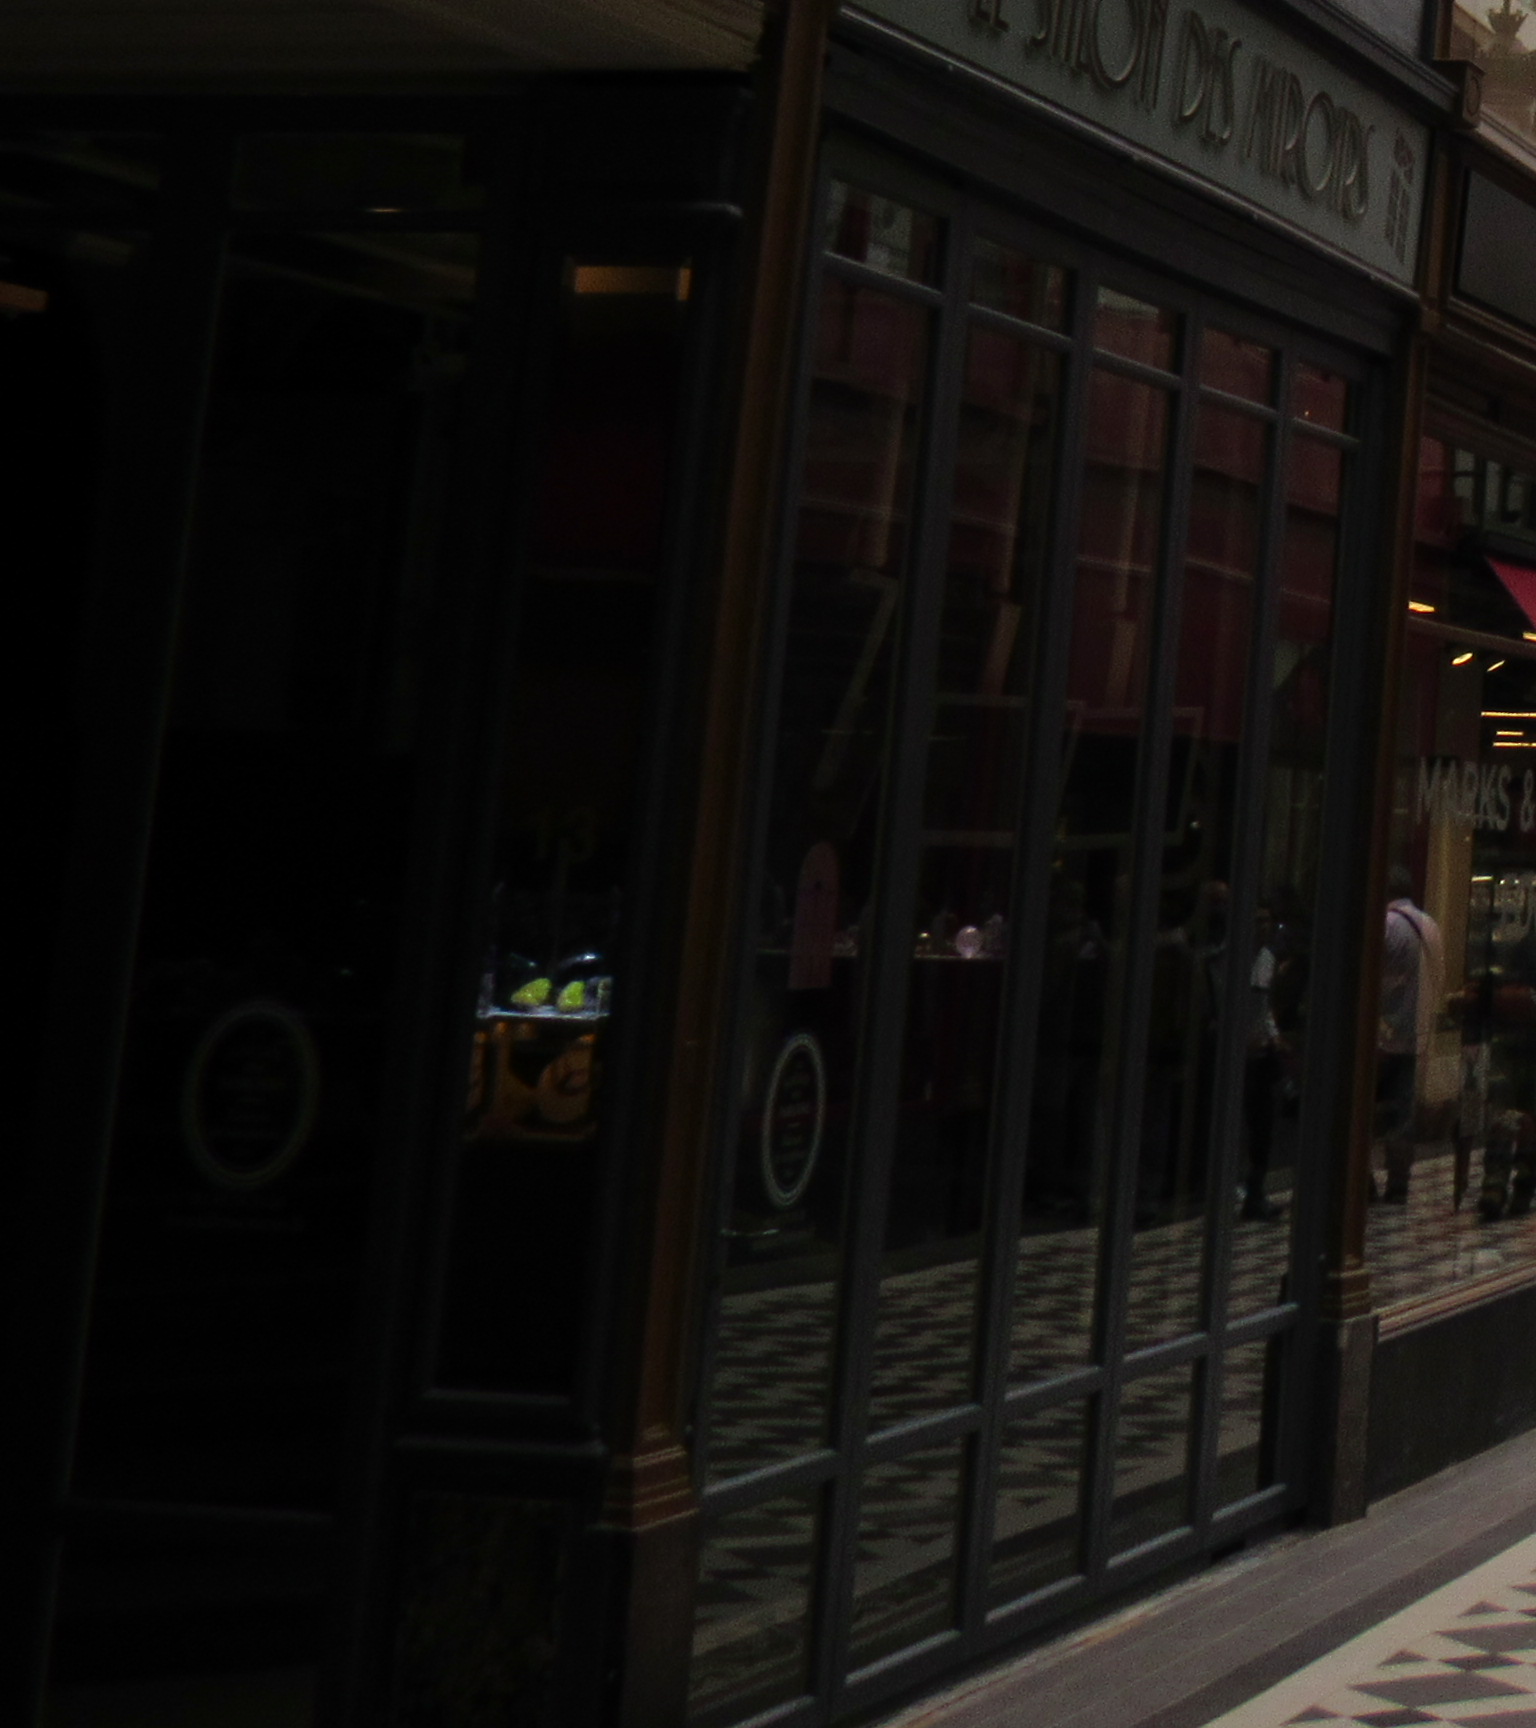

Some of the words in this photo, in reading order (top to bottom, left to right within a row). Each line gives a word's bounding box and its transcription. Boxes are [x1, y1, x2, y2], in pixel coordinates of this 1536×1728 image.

[1172, 6, 1241, 148] DES
[1242, 58, 1376, 222] MIROIRS
[1415, 756, 1513, 833] MARKS
[1519, 768, 1536, 834] &
